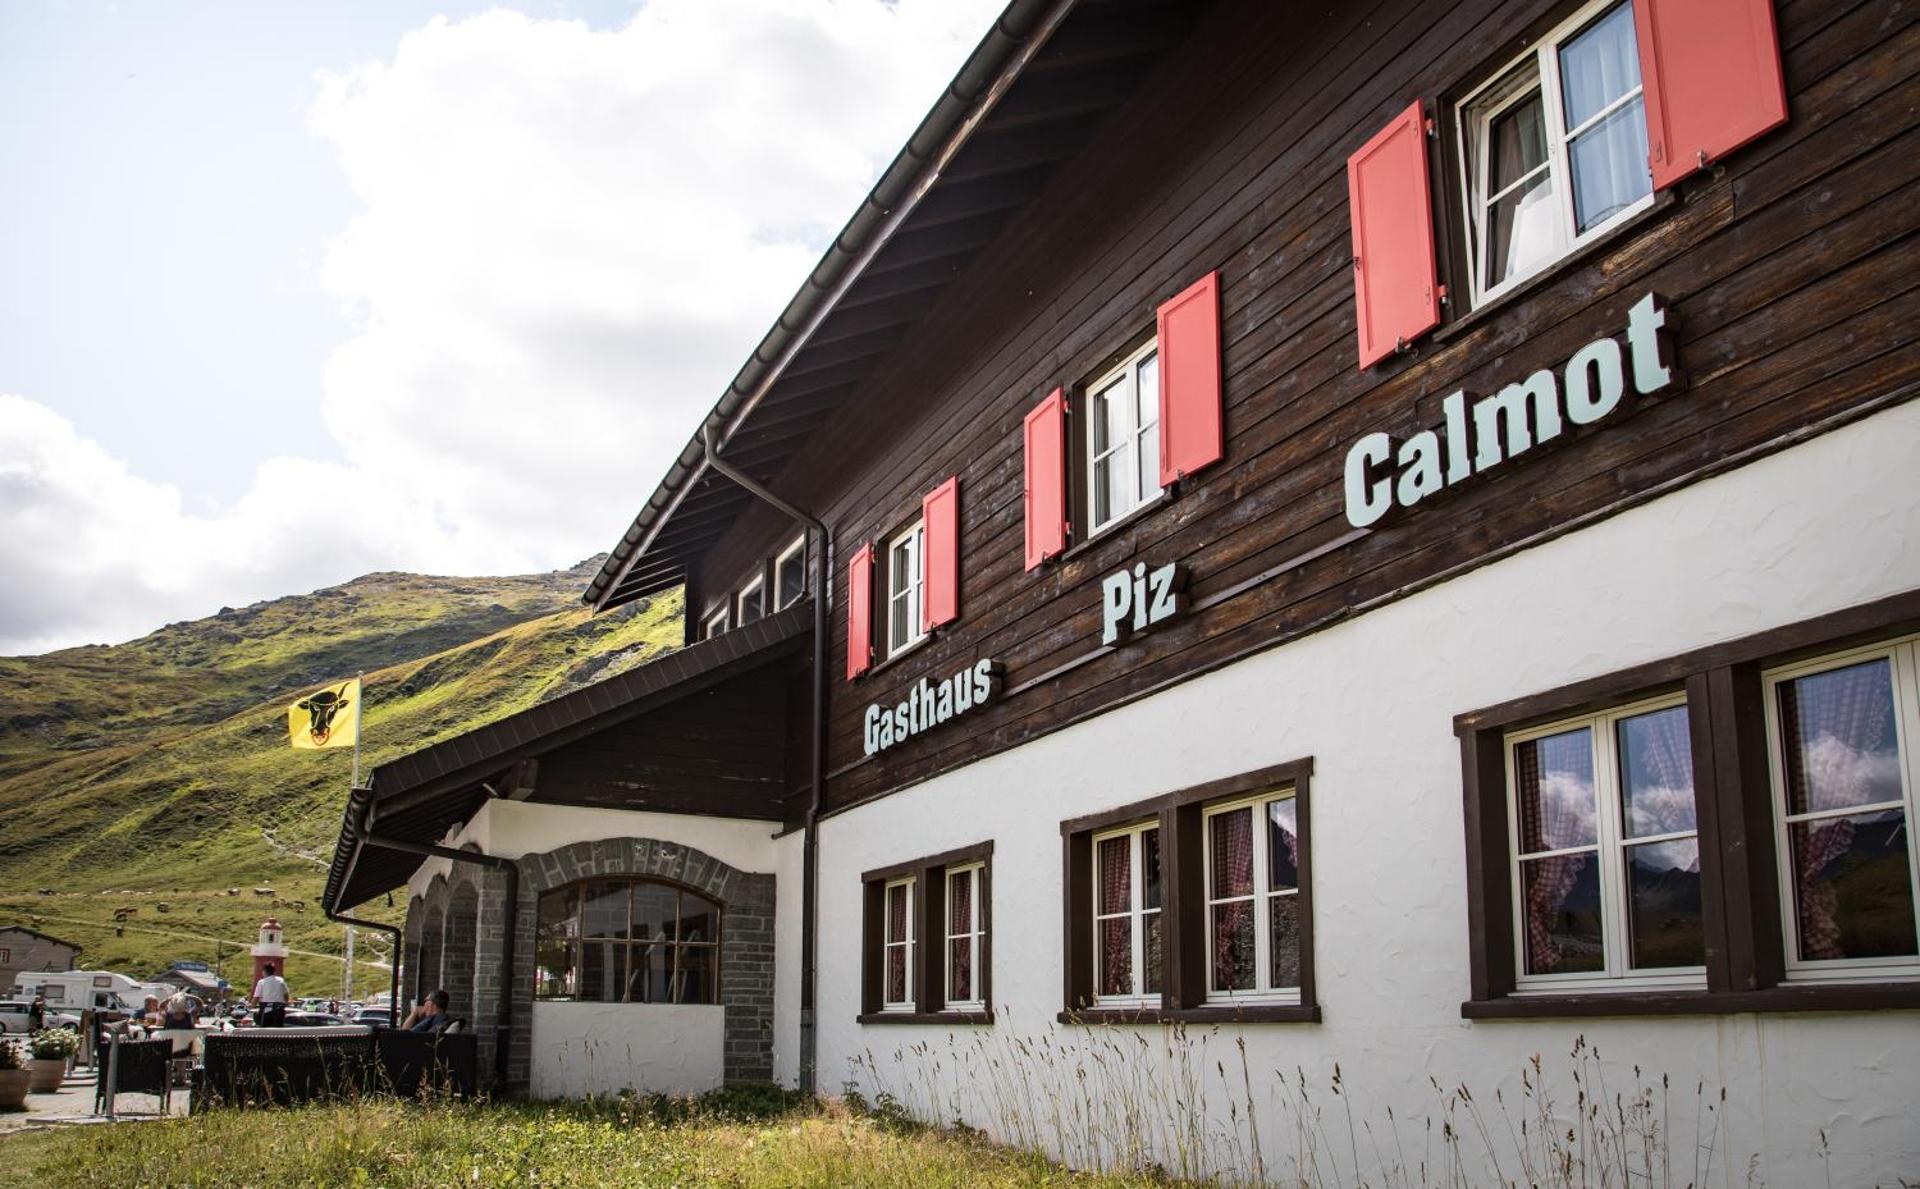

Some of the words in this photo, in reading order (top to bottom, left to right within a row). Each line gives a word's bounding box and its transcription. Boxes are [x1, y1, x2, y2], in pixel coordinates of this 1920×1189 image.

[863, 658, 992, 757] Gasthaus
[1102, 561, 1176, 646] Piz
[1343, 291, 1672, 529] Calmot
